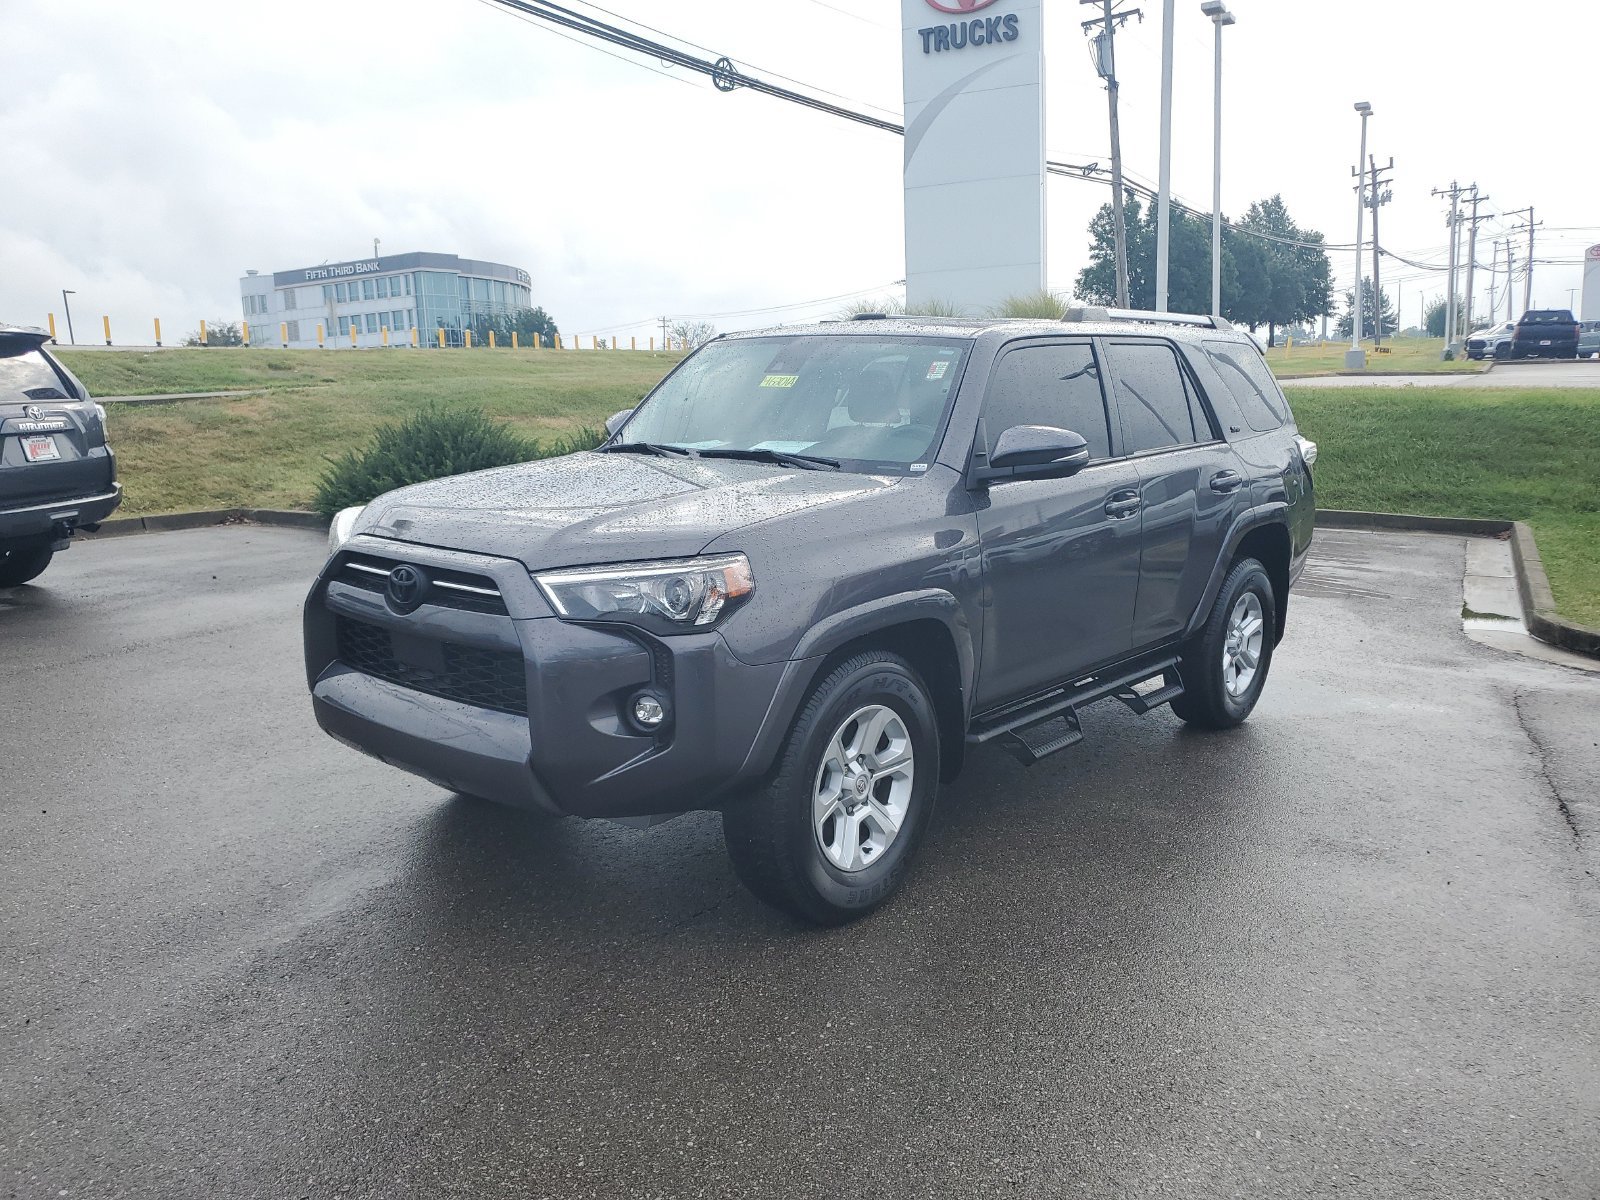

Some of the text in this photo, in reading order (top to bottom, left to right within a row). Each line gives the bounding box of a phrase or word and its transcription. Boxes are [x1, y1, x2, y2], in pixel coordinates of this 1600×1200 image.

[918, 13, 1019, 54] TRUCKS
[305, 262, 380, 280] FIFTH THIRD BANK
